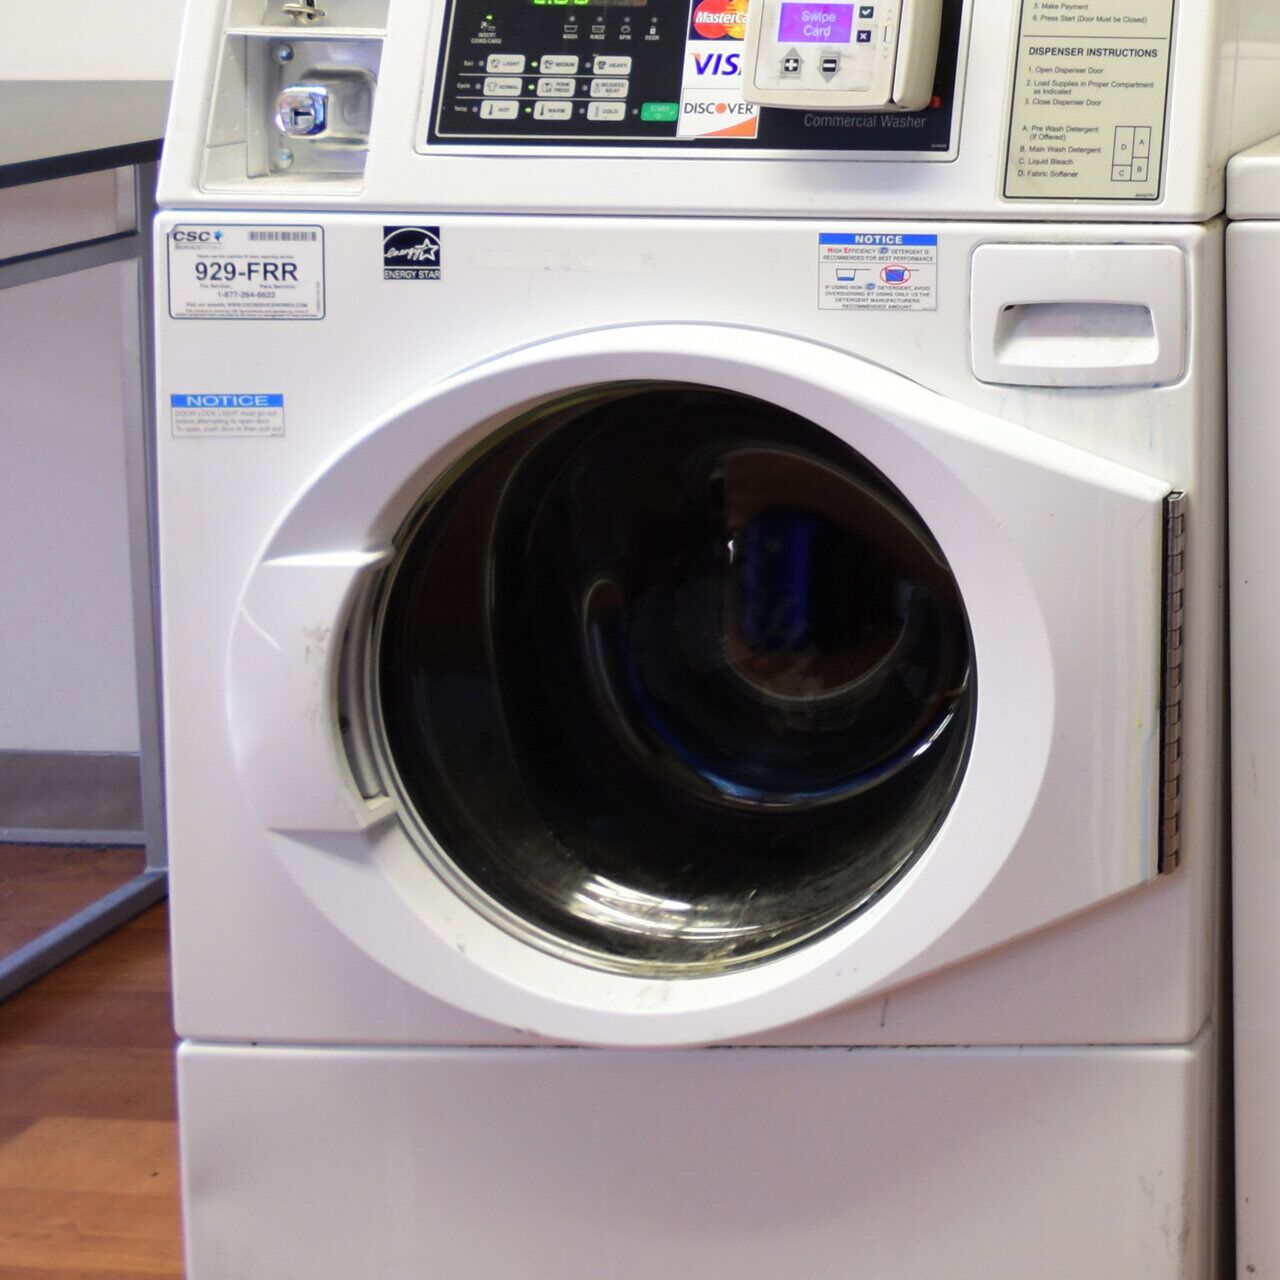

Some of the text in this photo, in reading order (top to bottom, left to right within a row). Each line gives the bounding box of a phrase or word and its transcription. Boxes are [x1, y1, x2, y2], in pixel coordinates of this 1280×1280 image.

[1061, 3, 1088, 11] Payment
[695, 11, 750, 24] MasterCa
[801, 10, 836, 23] Swipe
[1123, 16, 1147, 24] Closed)
[803, 25, 831, 37] Card
[1029, 47, 1158, 58] DISPENSER INSTRUCTIONS
[691, 53, 742, 75] VIS
[1054, 67, 1086, 75] Dispenser
[1088, 81, 1109, 89] Proper
[1111, 82, 1154, 90] Compartment
[1052, 99, 1084, 107] Dispenser
[684, 102, 754, 115] DISCOVER
[803, 114, 926, 128] Commercial Washer
[1066, 126, 1099, 134] Detergent
[1038, 134, 1066, 142] Offered)
[1068, 146, 1101, 155] Detergent
[1028, 158, 1048, 166] Liquid
[173, 231, 211, 242] CSC
[855, 235, 903, 244] NOTICE
[195, 262, 298, 282] 929-FRR
[384, 270, 440, 279] ENERGY STAR
[187, 396, 268, 406] NOTICE
